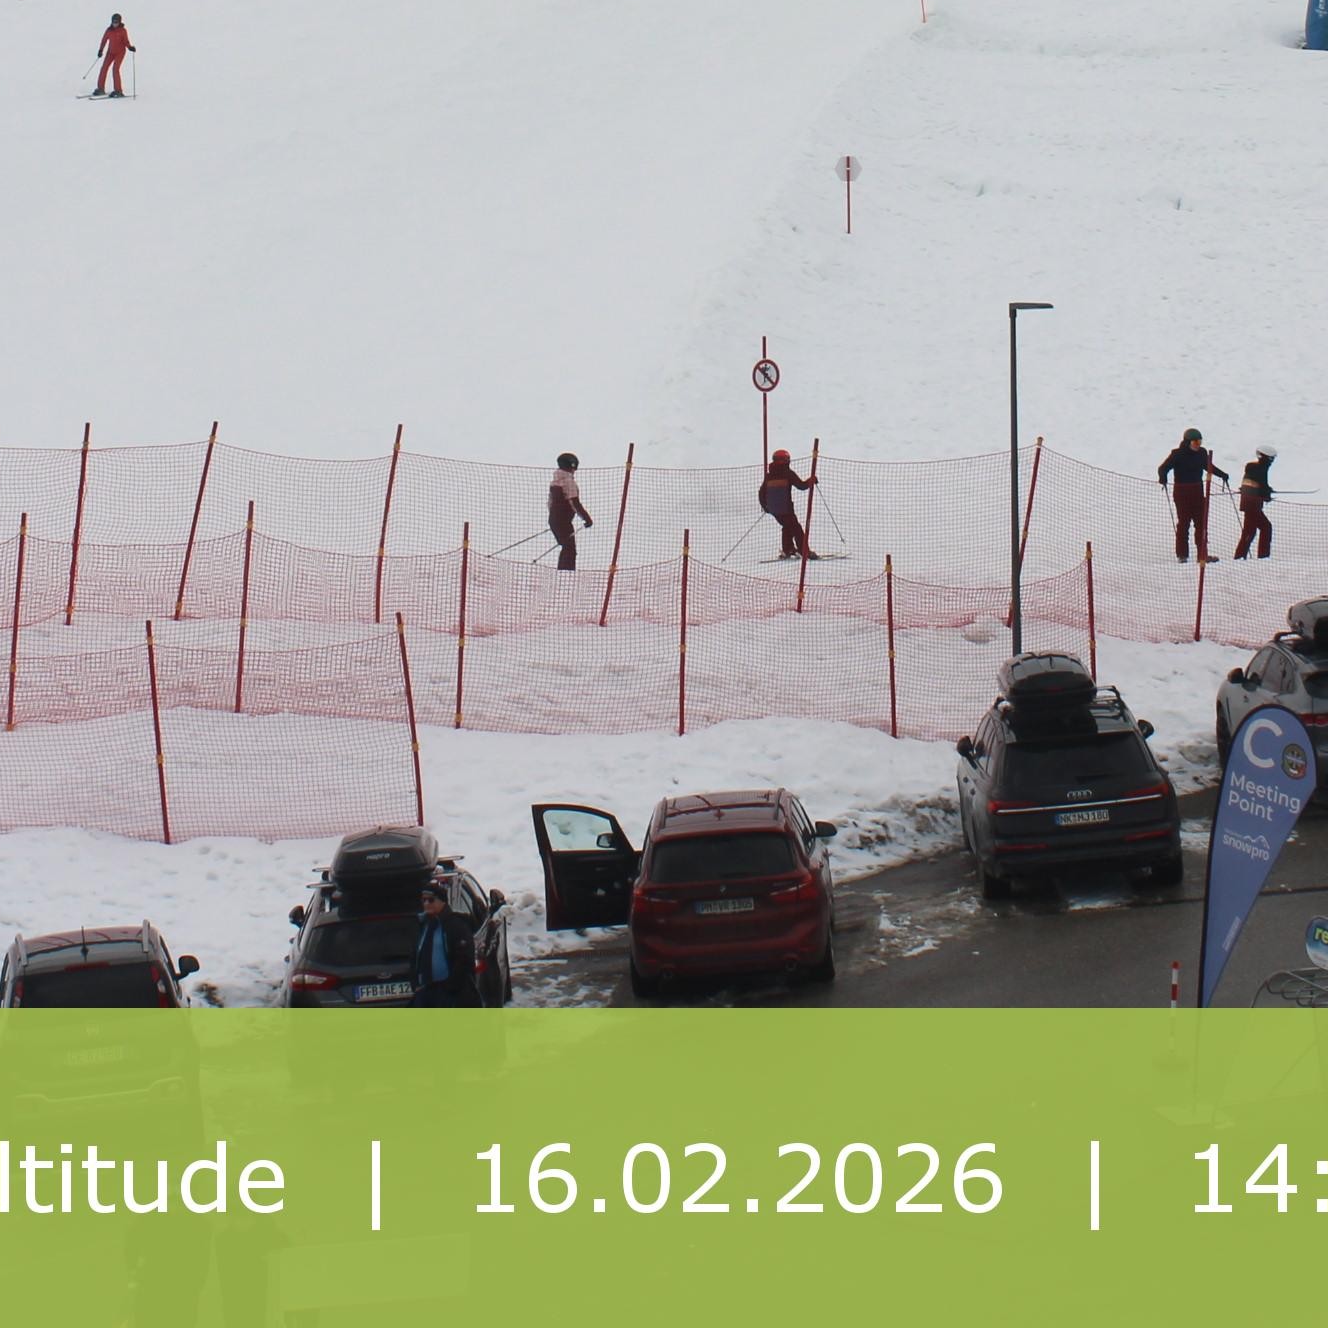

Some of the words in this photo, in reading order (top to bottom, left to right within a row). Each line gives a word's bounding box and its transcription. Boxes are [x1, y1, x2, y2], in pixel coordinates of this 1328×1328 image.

[1242, 718, 1283, 770] C
[1227, 790, 1275, 822] Point
[1229, 770, 1302, 814] Meeting
[1222, 834, 1270, 861] snowpro
[360, 985, 378, 998] FFB
[385, 984, 397, 996] AE
